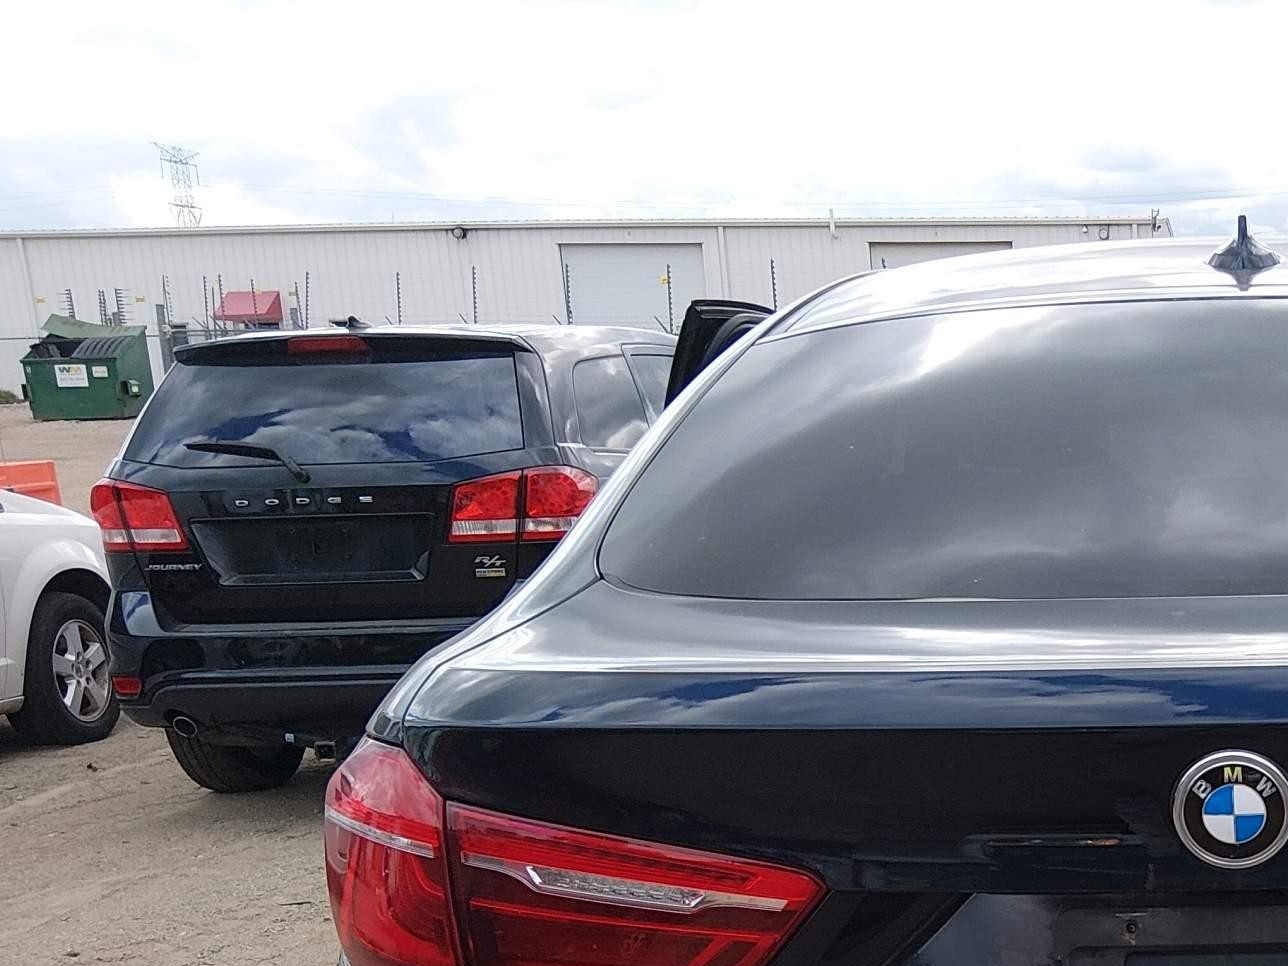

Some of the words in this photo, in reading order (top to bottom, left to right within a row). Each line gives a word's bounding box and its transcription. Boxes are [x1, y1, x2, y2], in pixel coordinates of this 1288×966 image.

[235, 495, 373, 507] DODGE
[144, 563, 202, 571] JOURNEY
[474, 555, 507, 567] R/T
[1191, 766, 1277, 799] BMW
